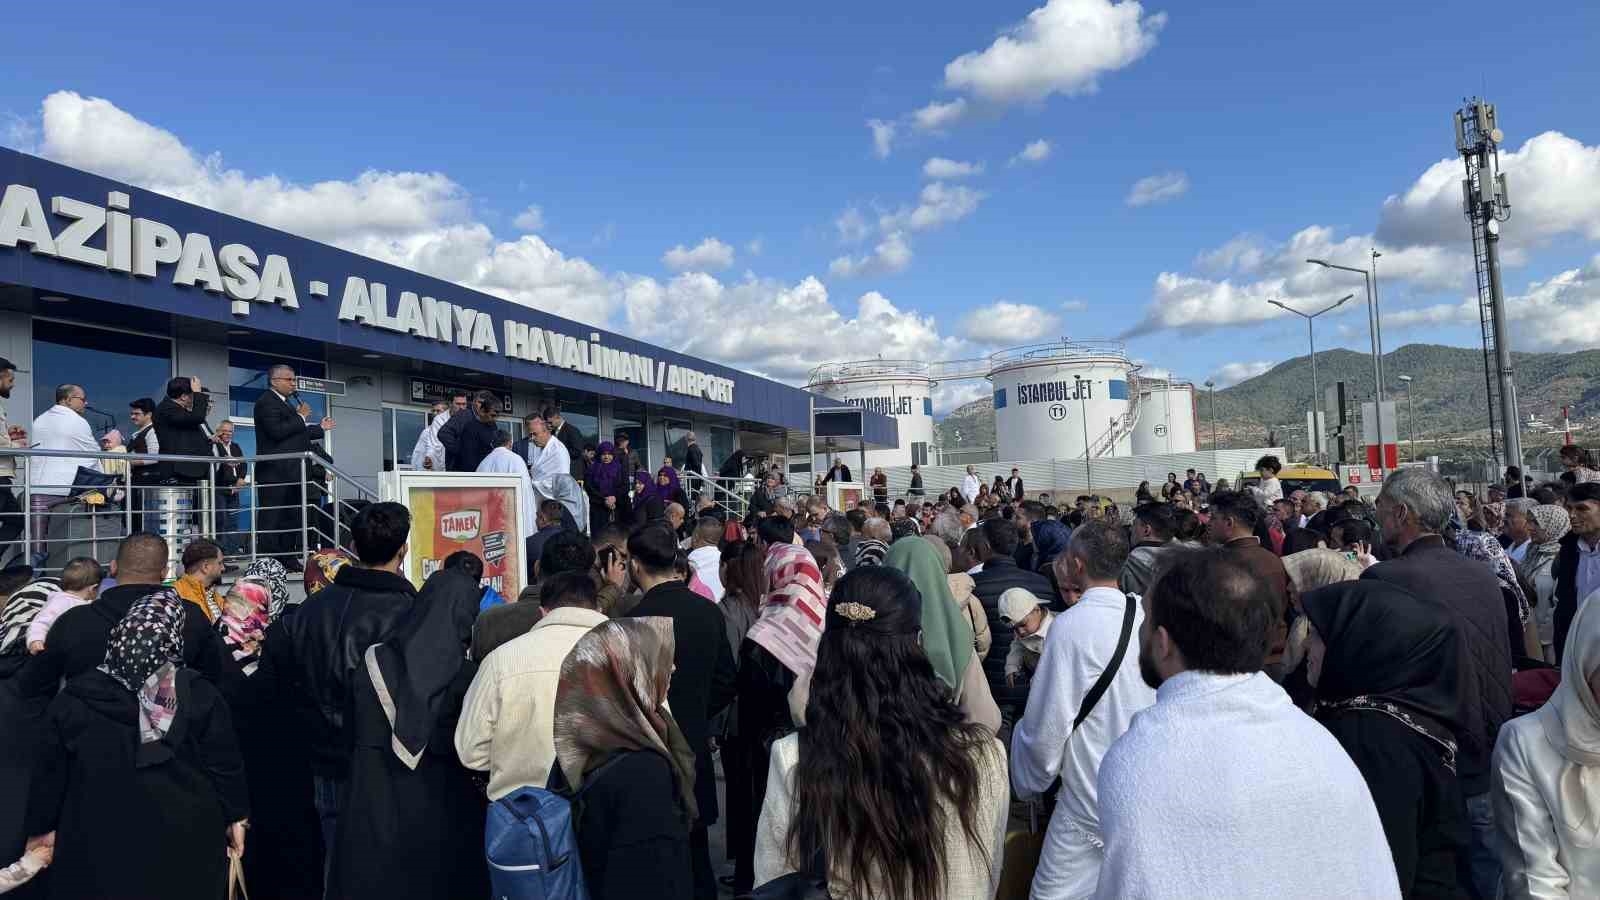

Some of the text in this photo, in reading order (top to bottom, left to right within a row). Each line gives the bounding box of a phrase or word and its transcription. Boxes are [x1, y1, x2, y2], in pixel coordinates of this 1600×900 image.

[338, 276, 499, 353] ALANYA
[504, 319, 655, 388] HAVALİMANI
[666, 363, 735, 405] AIRPORT
[1017, 379, 1092, 406] İSTANBUL JET
[844, 395, 912, 416] ANBUL JET
[1051, 407, 1063, 417] T1
[442, 515, 478, 533] TAMEK
